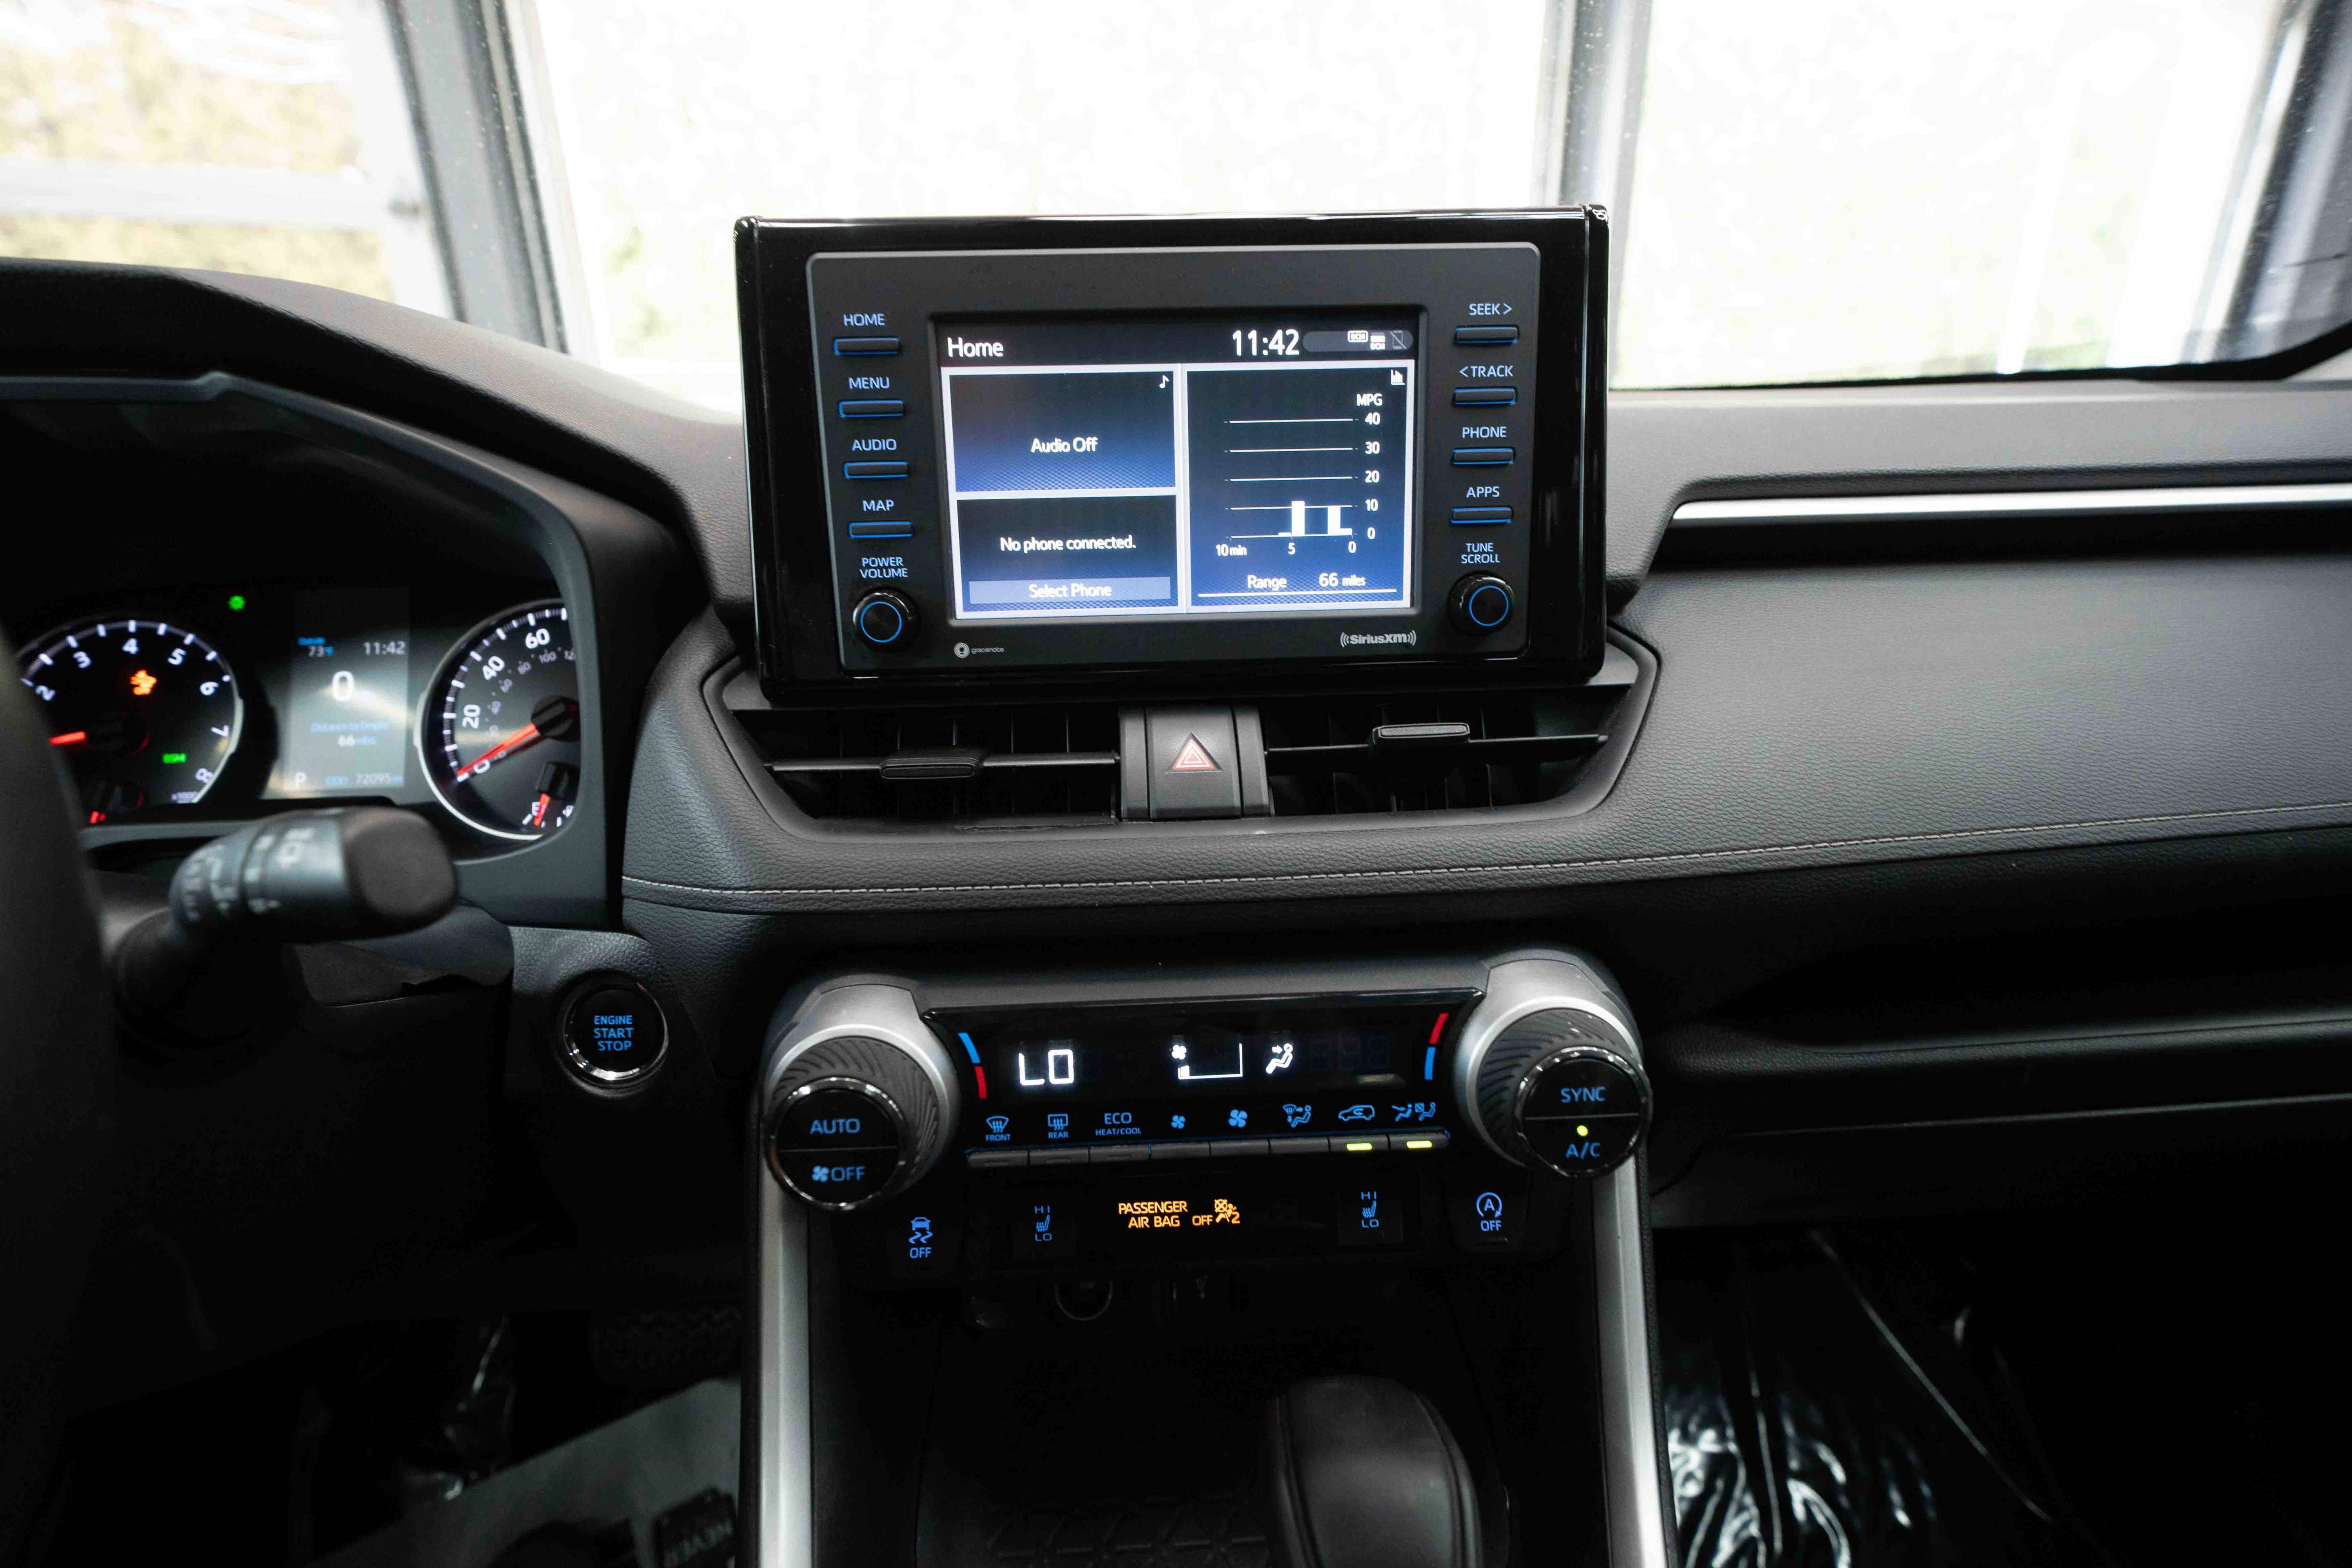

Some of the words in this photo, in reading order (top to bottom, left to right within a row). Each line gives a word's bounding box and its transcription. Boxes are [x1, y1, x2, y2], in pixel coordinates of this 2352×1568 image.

[1469, 303, 1501, 315] SEEK
[843, 313, 885, 326] HOME
[948, 337, 1004, 357] Home
[1232, 329, 1300, 356] 11:42
[1471, 365, 1513, 377] TRACK
[849, 376, 890, 390] MENU
[1356, 393, 1383, 406] MPG
[1365, 412, 1381, 425] 40
[1462, 426, 1507, 438] PHONE
[852, 439, 897, 451] AUDIO
[1031, 438, 1070, 453] Audio
[1073, 437, 1098, 452] Off
[1365, 441, 1380, 454] 30
[1365, 470, 1380, 483] 20
[1466, 486, 1500, 498] APPS
[862, 500, 894, 512] MAP
[1365, 498, 1379, 512] 10
[1367, 527, 1376, 540] 0
[1000, 537, 1021, 551] No
[1023, 537, 1063, 554] phone
[1066, 534, 1136, 550] connected.
[1216, 543, 1229, 556] 10
[1229, 544, 1247, 556] min
[1288, 542, 1296, 555] 5
[1348, 541, 1356, 553] 0
[1466, 542, 1493, 552] TUNE
[862, 557, 904, 567] POWER
[1461, 553, 1500, 564] SCROLL
[859, 568, 908, 579] VOLUME
[1247, 575, 1287, 591] Range
[1319, 572, 1339, 587] 66
[1342, 574, 1366, 586] miles
[1029, 584, 1068, 598] Select
[1071, 582, 1112, 597] Phone
[525, 628, 550, 649] 60
[122, 638, 138, 654] 4
[364, 641, 405, 655] 11:42
[73, 651, 91, 668] 3
[167, 648, 186, 666] 5
[482, 656, 505, 680] 40
[200, 681, 219, 695] 6
[332, 670, 354, 701] 0
[35, 685, 56, 701] 2
[462, 704, 481, 728] 20
[211, 725, 229, 737] 7
[295, 772, 307, 788] P
[594, 1015, 633, 1025] ENGINE
[594, 1027, 634, 1038] START
[597, 1040, 632, 1051] STOP
[1018, 1049, 1074, 1086] LO
[1561, 1086, 1605, 1103] SYNC
[1104, 1112, 1132, 1125] ECO
[810, 1118, 860, 1134] AUTO
[1095, 1127, 1141, 1136] HEAT/COOL
[1566, 1141, 1600, 1159] A/C
[831, 1166, 865, 1182] OFF
[1361, 1191, 1377, 1200] HI
[1034, 1205, 1050, 1214] HI
[1118, 1200, 1188, 1215] PASSENGER
[1128, 1216, 1150, 1229] AIR
[1154, 1215, 1180, 1227] BAG
[1192, 1214, 1213, 1226] OFF
[1361, 1219, 1379, 1228] LO
[1480, 1220, 1501, 1232] OFF
[1034, 1233, 1052, 1242] LO
[909, 1247, 931, 1258] OFF
